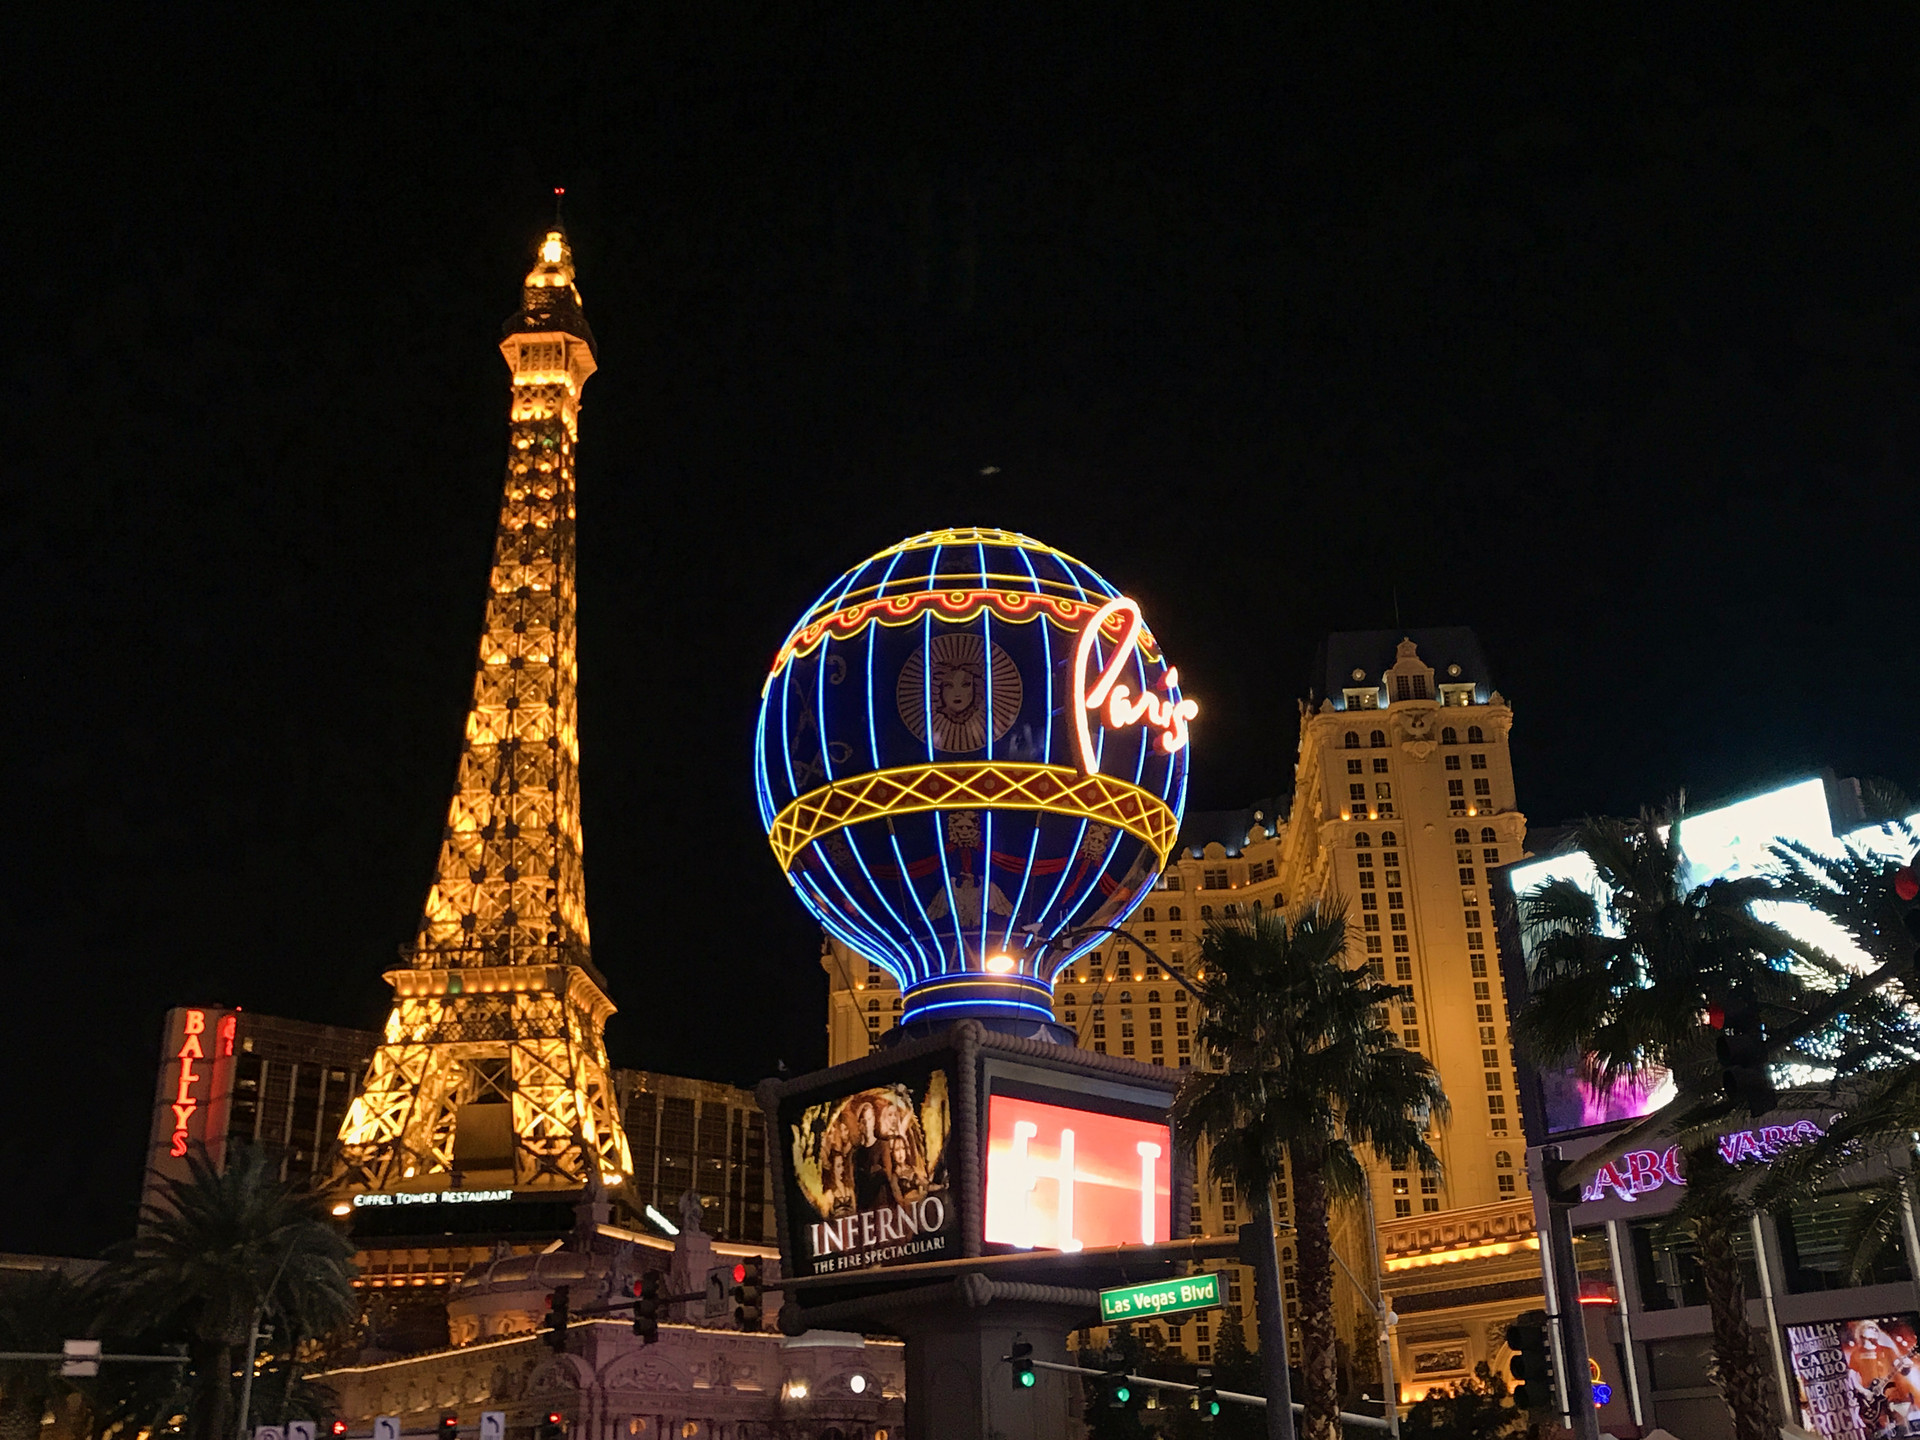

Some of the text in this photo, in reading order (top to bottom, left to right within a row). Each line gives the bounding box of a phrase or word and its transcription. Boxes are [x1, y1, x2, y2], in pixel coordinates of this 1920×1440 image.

[1074, 597, 1198, 774] Paris
[353, 1190, 513, 1207] EIFFEL TOWER RESTAURANT
[811, 1196, 945, 1257] INFERNO
[813, 1236, 945, 1274] THE FIRE SPECTACULAR!
[1105, 1282, 1214, 1314] Las Vegas Blvd
[1787, 1323, 1837, 1345] KILLER
[1798, 1349, 1842, 1368] CABO
[1800, 1361, 1846, 1380] WABO
[1805, 1378, 1854, 1398] MEXICAN
[1809, 1391, 1859, 1414] FOOD &
[1814, 1407, 1866, 1436] ROCK
